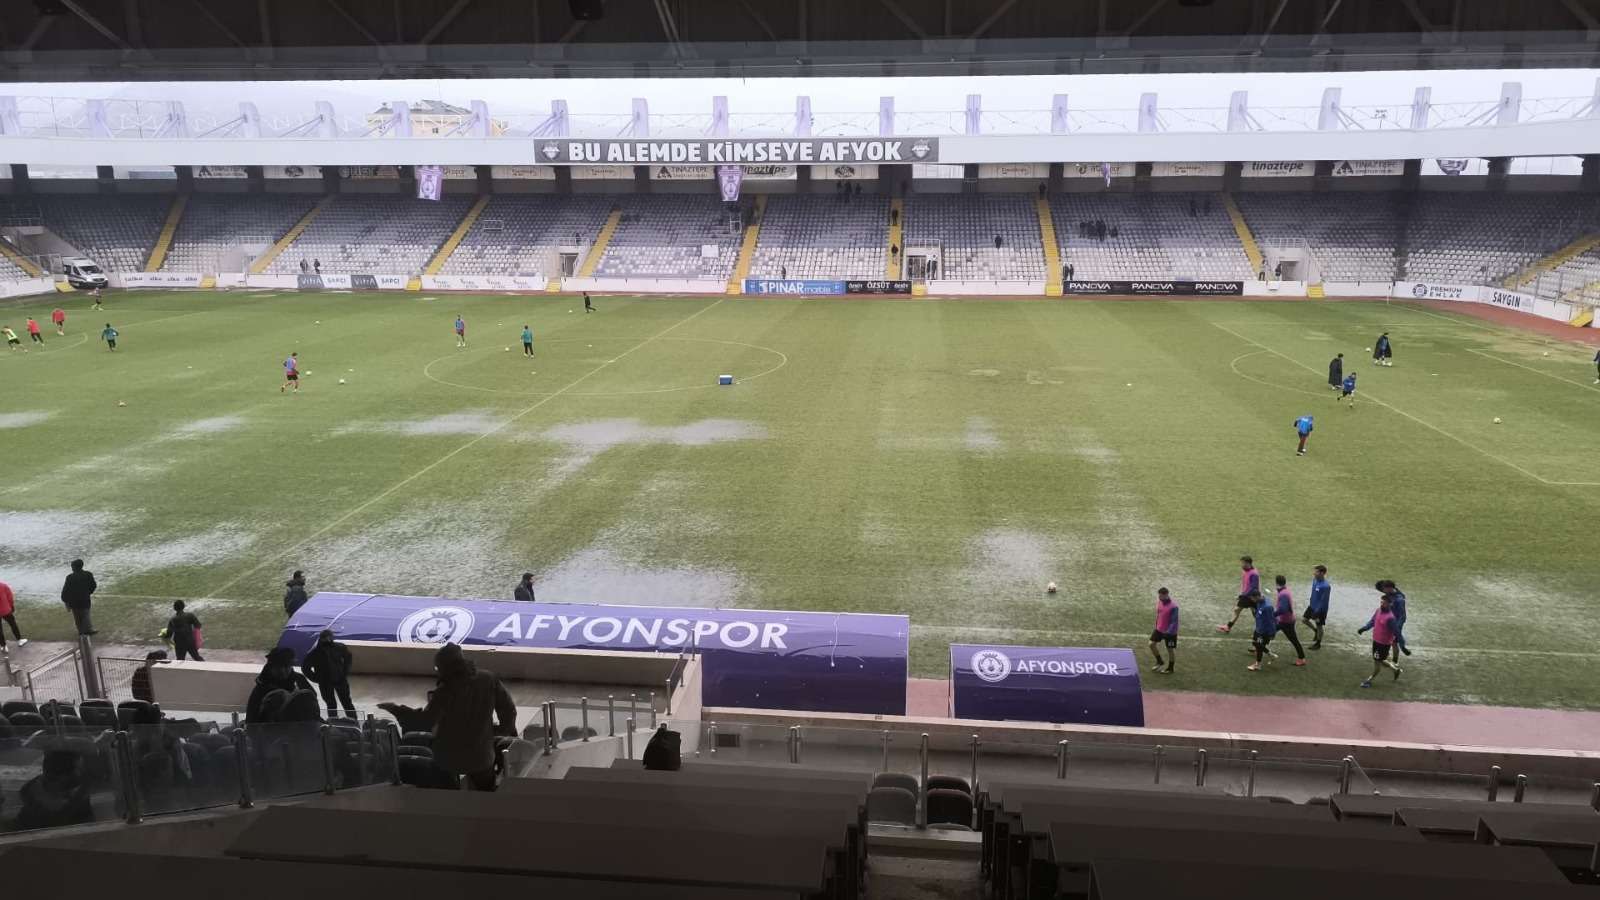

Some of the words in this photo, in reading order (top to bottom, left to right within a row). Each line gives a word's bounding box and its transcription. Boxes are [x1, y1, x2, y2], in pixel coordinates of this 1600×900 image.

[568, 142, 600, 161] BU
[607, 142, 700, 162] ALEMDE
[708, 141, 813, 162] KİMSEYE
[820, 141, 902, 161] AFYOK
[769, 281, 804, 293] PINAR
[867, 280, 890, 289] ÖZSÜT
[1492, 291, 1521, 308] SAYGIN
[487, 612, 788, 649] AFYONSPOR
[1016, 659, 1119, 675] AFYONSPOR
